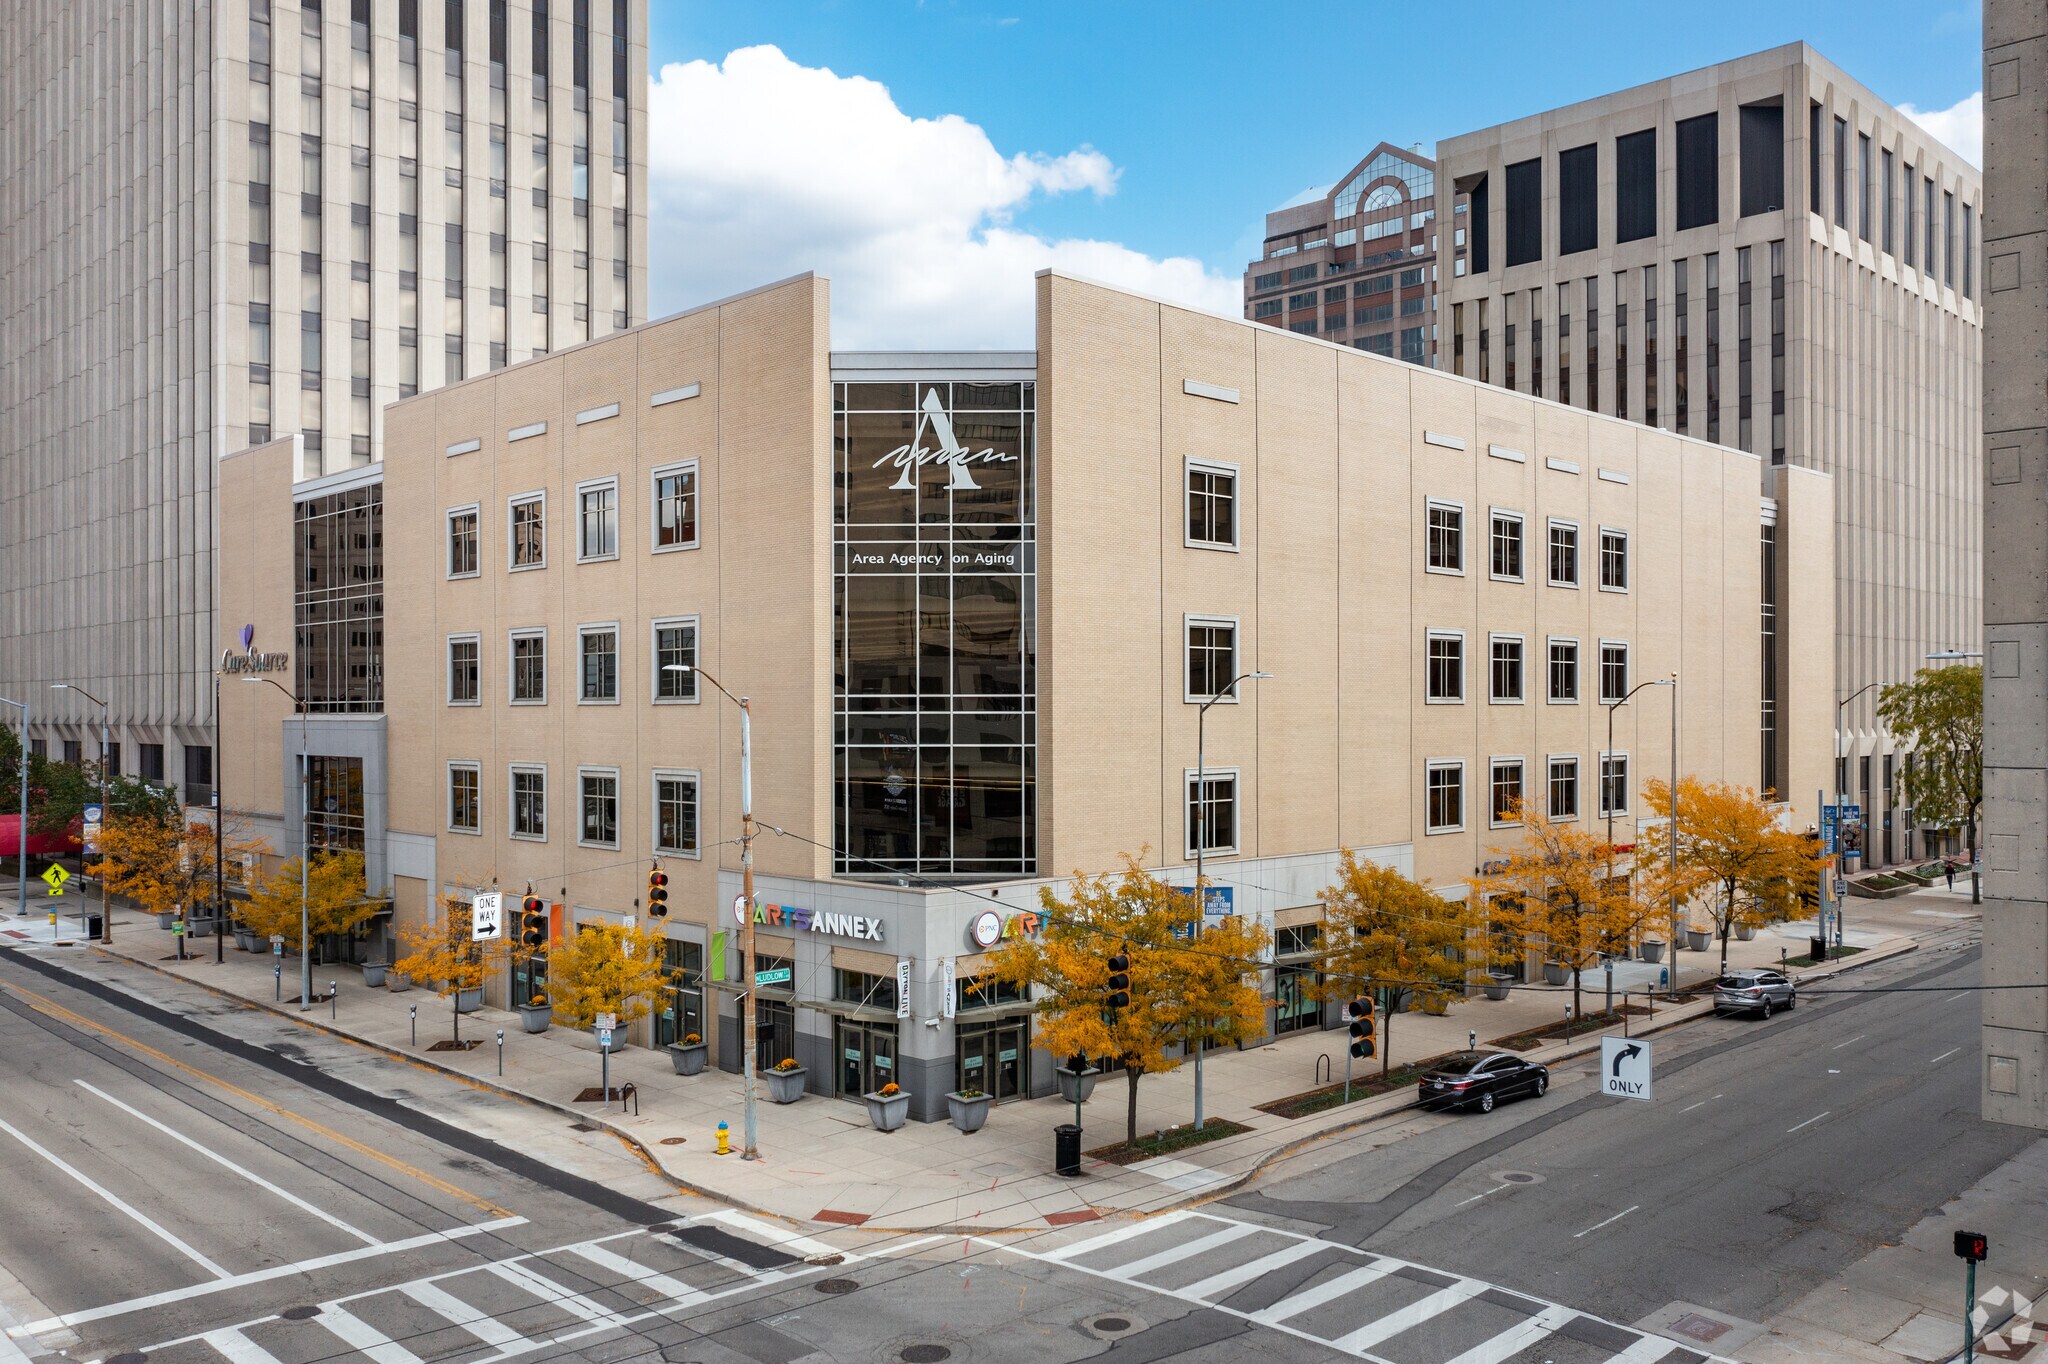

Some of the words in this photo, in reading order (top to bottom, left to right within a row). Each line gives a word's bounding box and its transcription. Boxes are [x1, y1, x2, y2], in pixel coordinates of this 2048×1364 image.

[852, 553, 885, 564] Area
[889, 553, 943, 566] Agency
[952, 555, 969, 564] on
[974, 553, 1015, 566] Aging
[222, 646, 288, 674] CareSource
[479, 897, 496, 908] ONE
[479, 910, 496, 922] WAY
[985, 924, 997, 932] PNC
[759, 971, 784, 982] LUDLOW
[901, 964, 909, 996] DAYTON
[901, 997, 909, 1015] LIVE
[1609, 1079, 1643, 1094] ONLY
